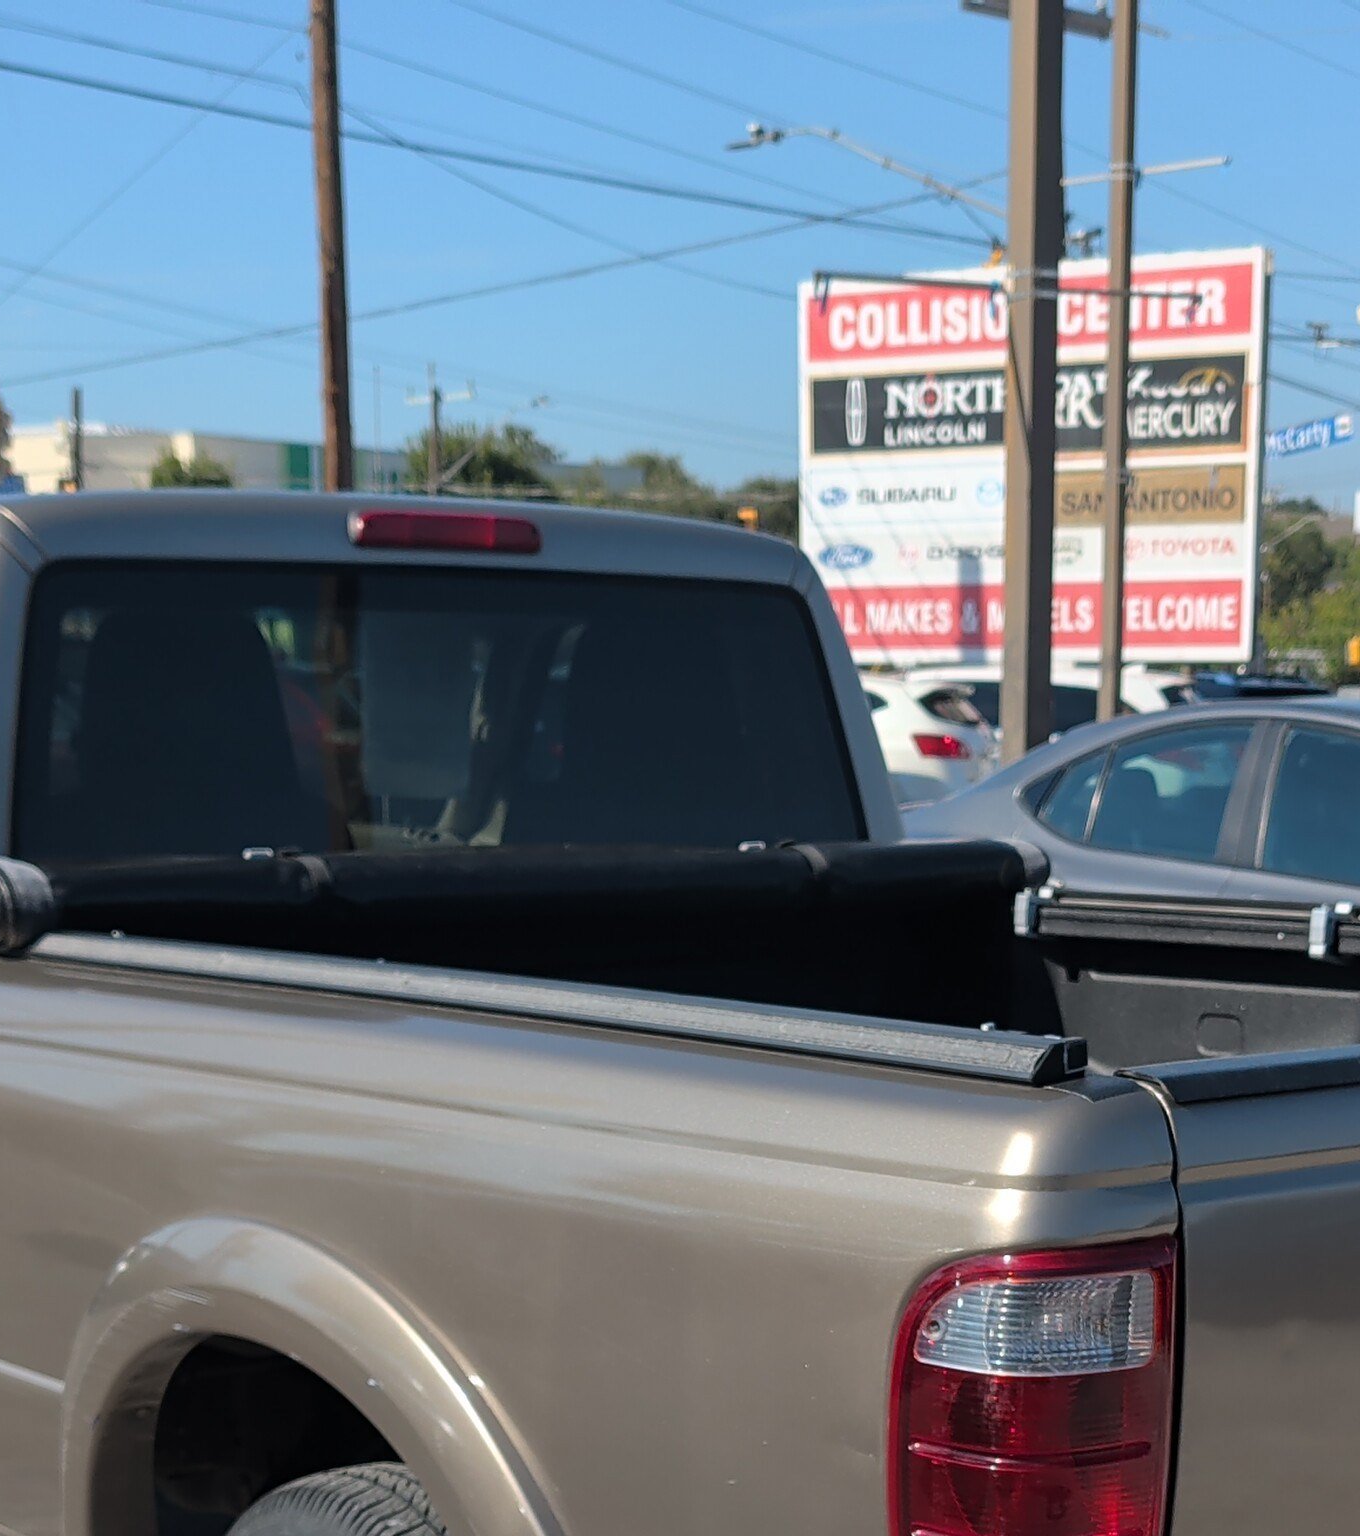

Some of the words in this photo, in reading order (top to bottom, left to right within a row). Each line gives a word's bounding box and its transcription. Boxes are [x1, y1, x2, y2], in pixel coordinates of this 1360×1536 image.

[828, 290, 1009, 352] COLLISIO
[883, 418, 987, 447] LINCOLN
[856, 486, 957, 505] SUBARU
[1125, 486, 1237, 514] ANTONIO
[926, 544, 1006, 561] DODG
[1151, 538, 1238, 558] TOYOTA
[865, 598, 954, 636] MAKES
[1124, 594, 1238, 632] ELCOME
